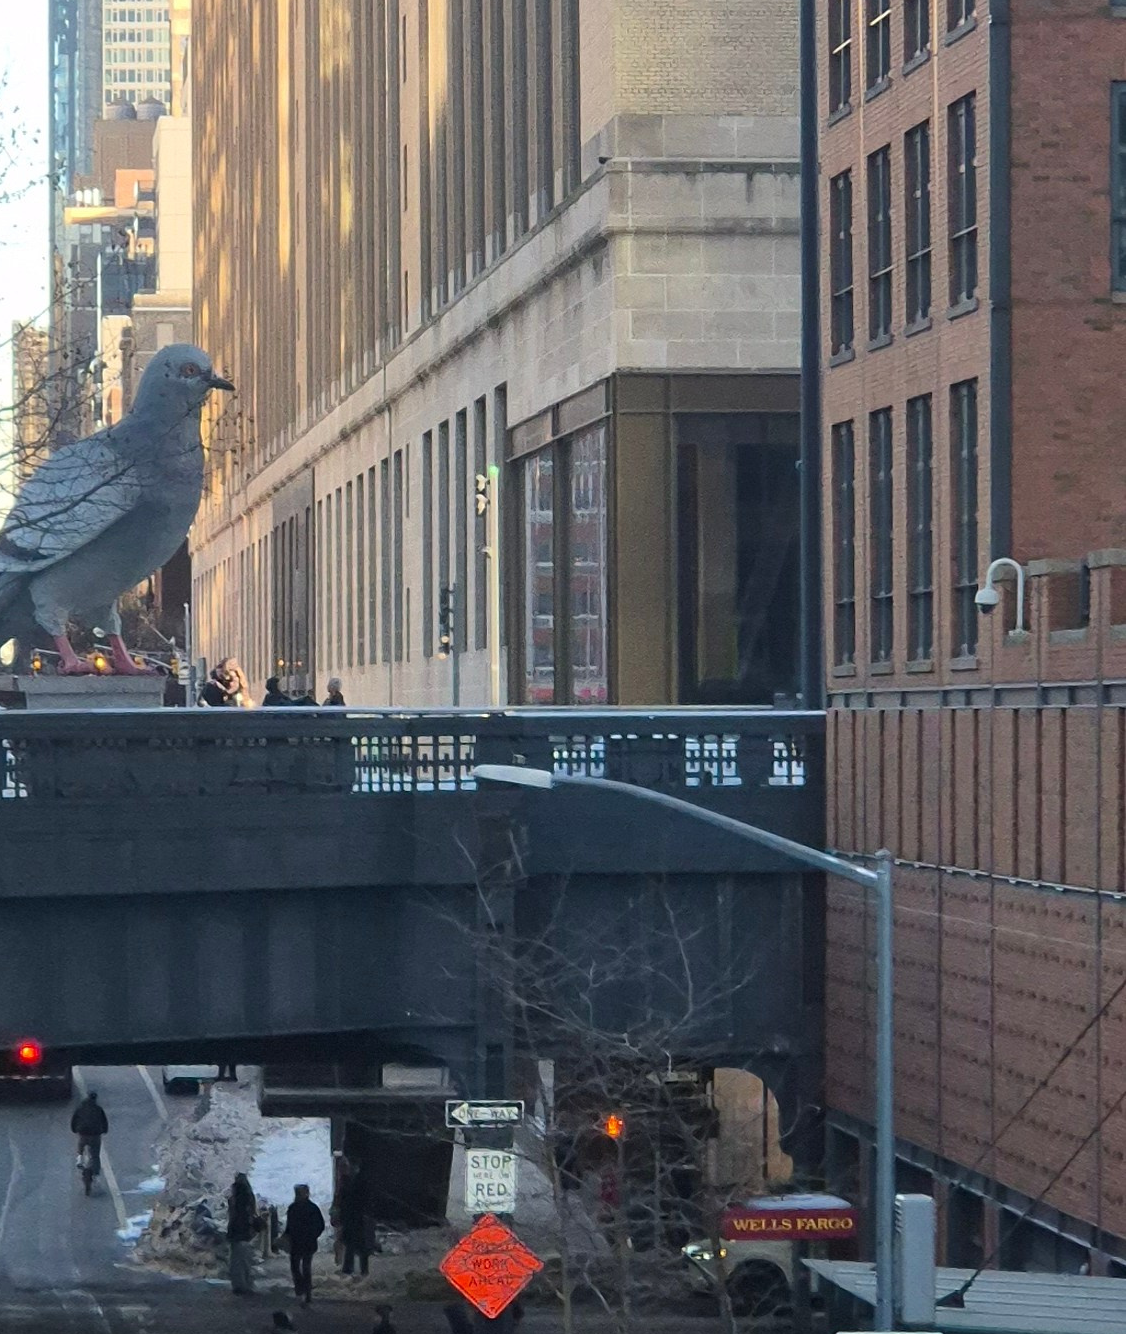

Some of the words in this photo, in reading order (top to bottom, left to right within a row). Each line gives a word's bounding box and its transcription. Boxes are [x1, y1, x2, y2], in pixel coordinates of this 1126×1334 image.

[470, 1155, 512, 1169] STOP
[475, 1182, 507, 1197] RED
[733, 1217, 793, 1231] WELLS
[796, 1217, 854, 1230] FARGO
